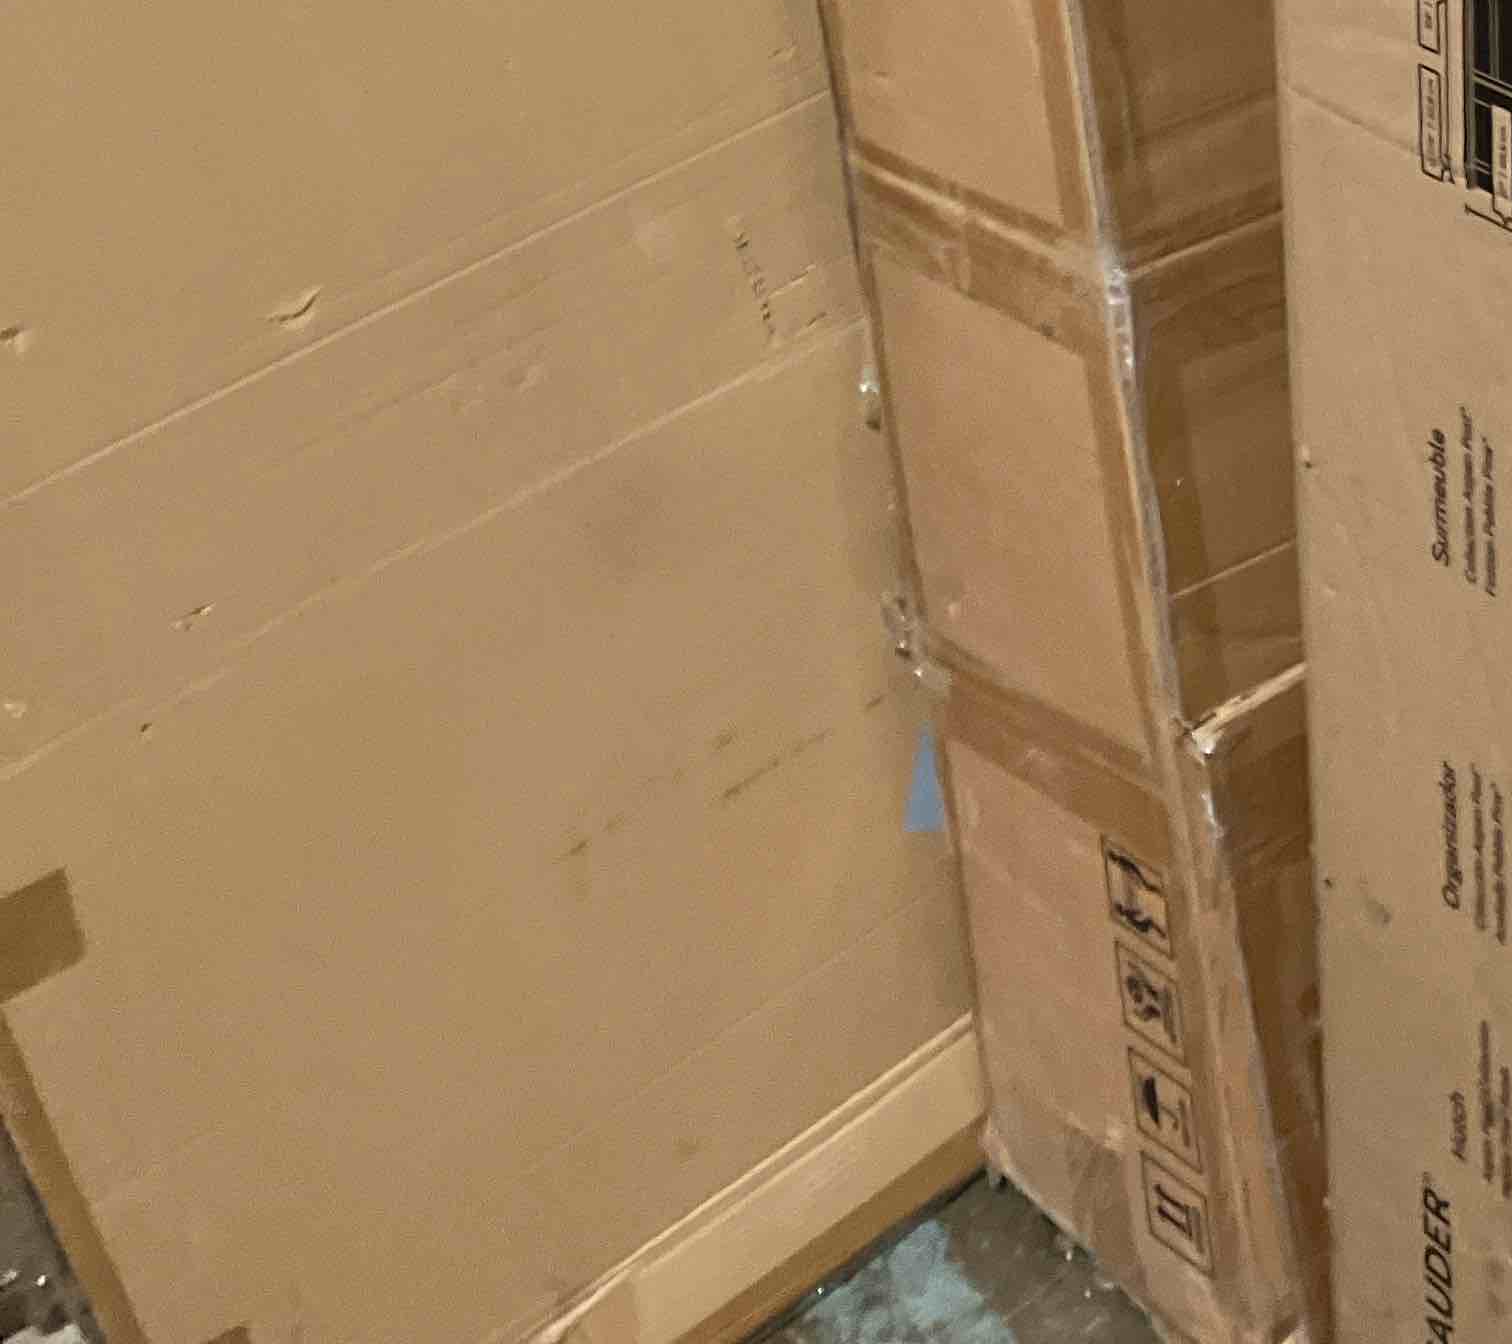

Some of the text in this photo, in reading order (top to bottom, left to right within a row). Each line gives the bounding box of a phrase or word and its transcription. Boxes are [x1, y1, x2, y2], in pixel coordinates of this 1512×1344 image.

[1427, 427, 1450, 567] Surmeuble
[1440, 761, 1462, 910] Organizador
[1423, 1187, 1453, 1344] AUDER
